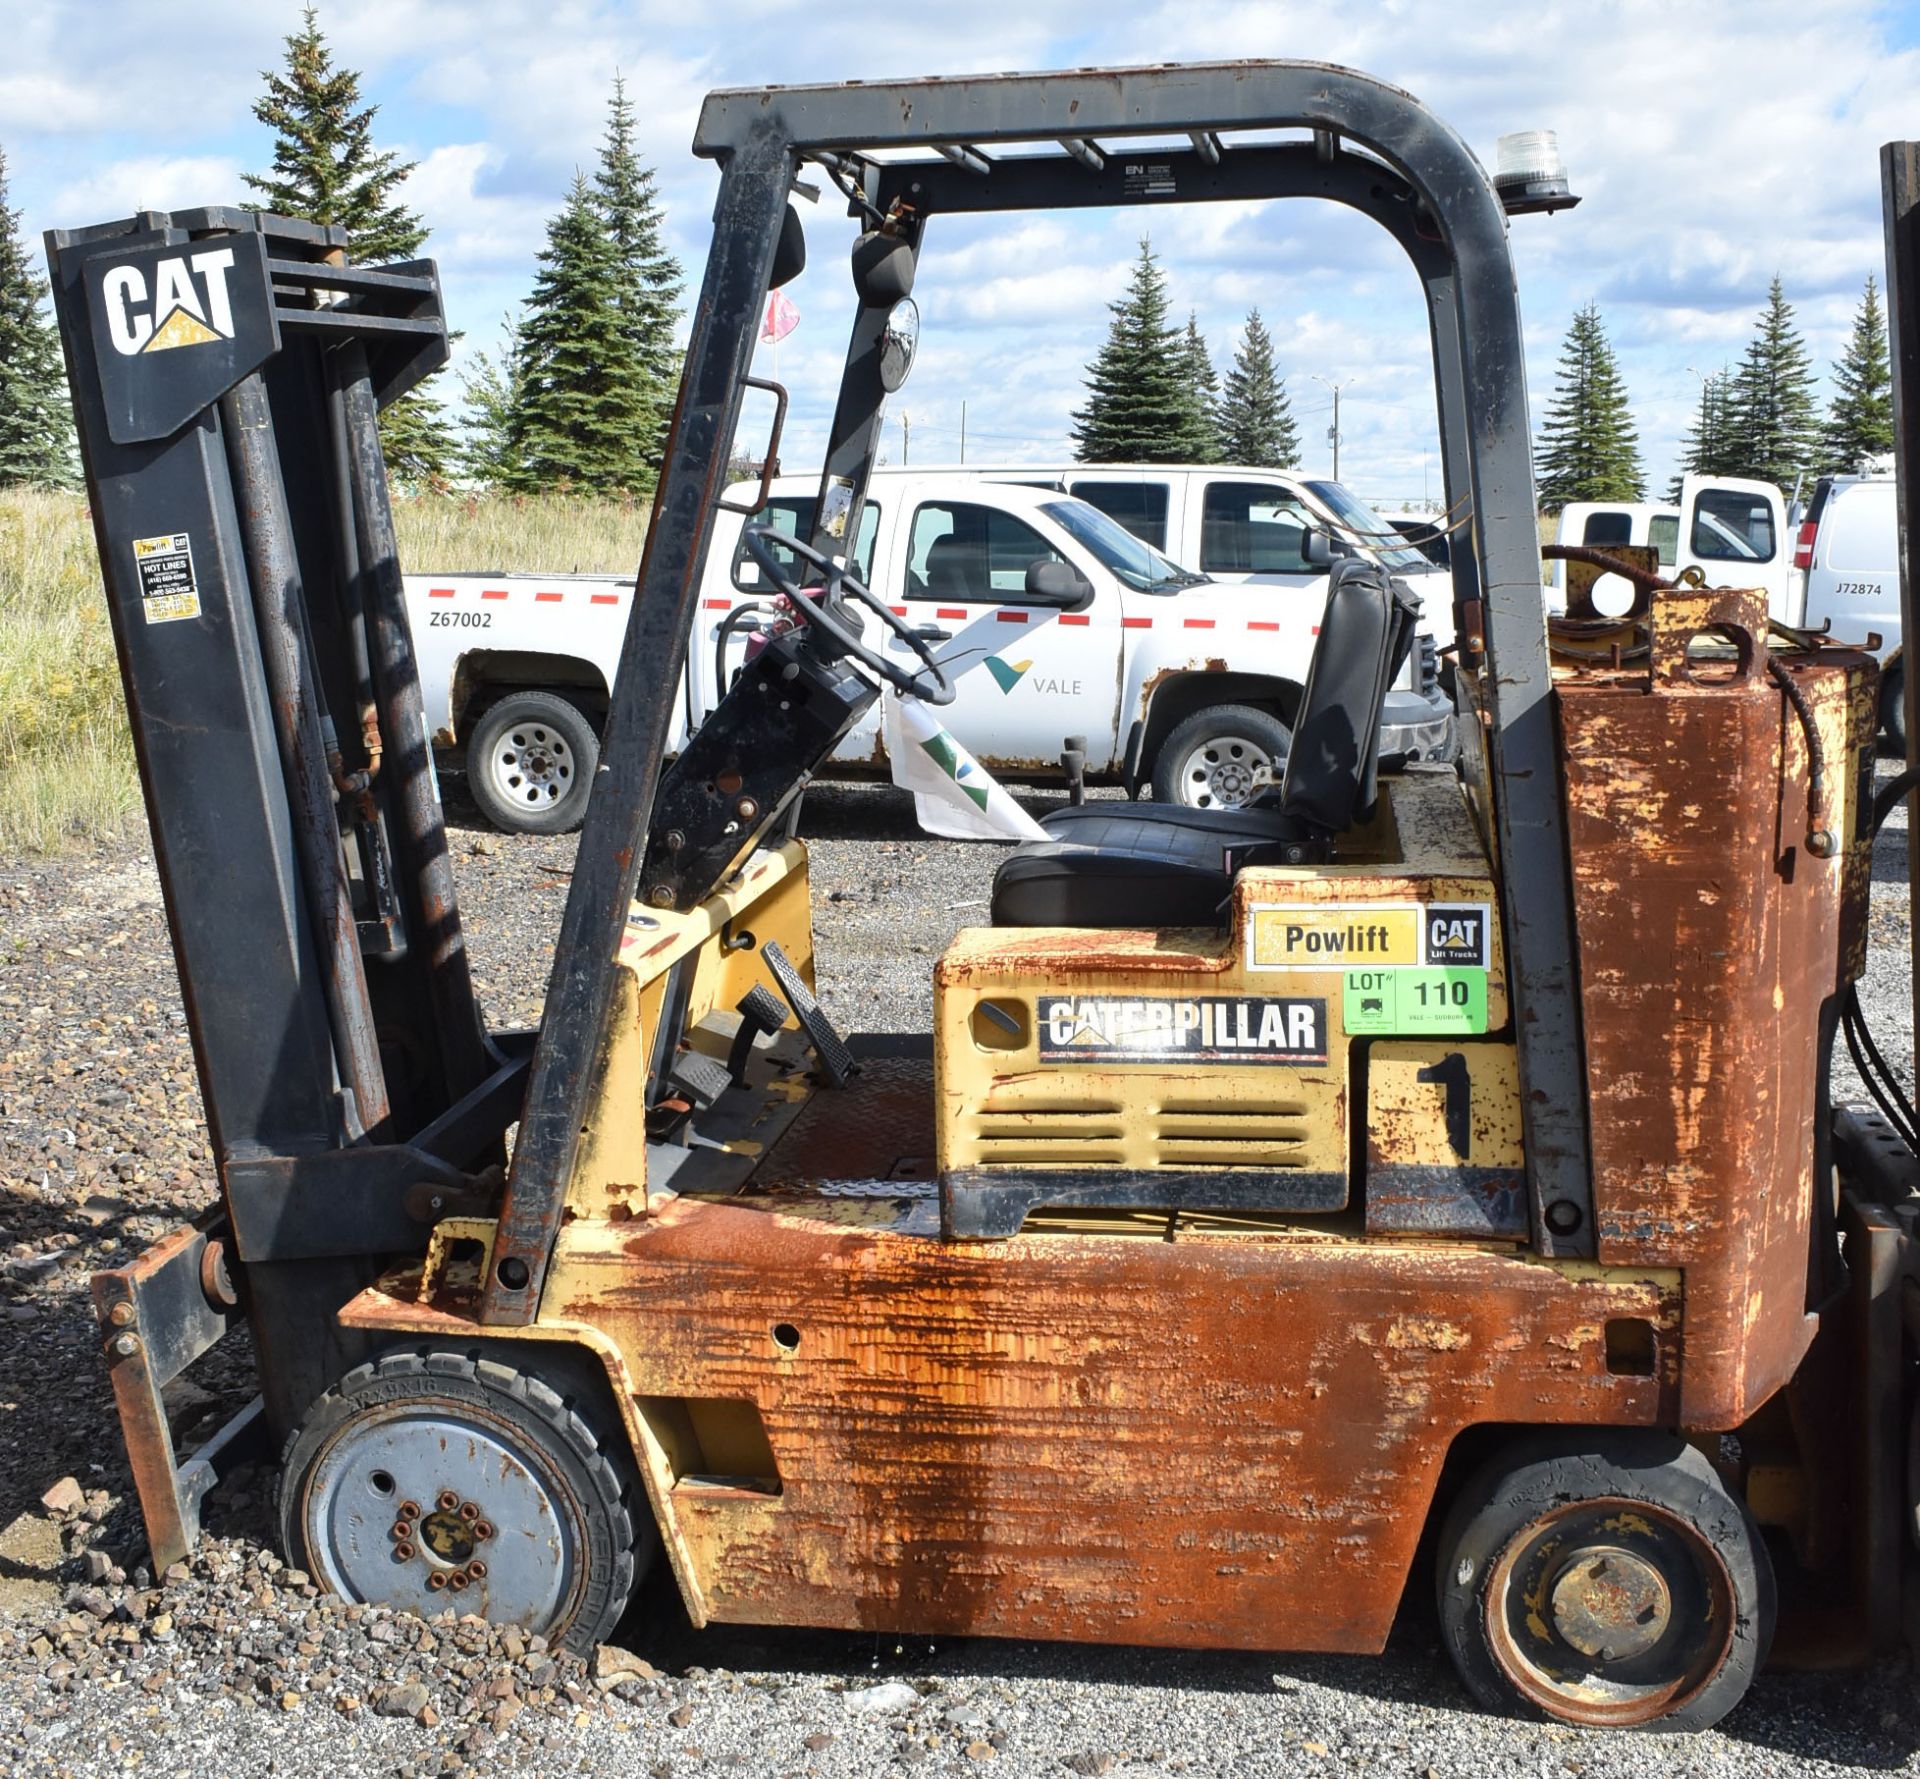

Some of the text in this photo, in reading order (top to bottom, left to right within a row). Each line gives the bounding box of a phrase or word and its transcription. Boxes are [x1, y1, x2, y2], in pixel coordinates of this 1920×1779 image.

[103, 248, 235, 355] CAT
[144, 560, 186, 573] HOT LINES
[1835, 583, 1882, 595] J72874
[429, 611, 492, 628] Z67002
[1033, 678, 1082, 695] VALE
[1286, 925, 1389, 952] Powlift
[1431, 920, 1478, 947] CAT
[1431, 950, 1478, 959] Lift Trucks
[1414, 981, 1469, 1006] 110
[1050, 1002, 1317, 1049] CATERPILLAR
[1417, 1053, 1470, 1161] 1
